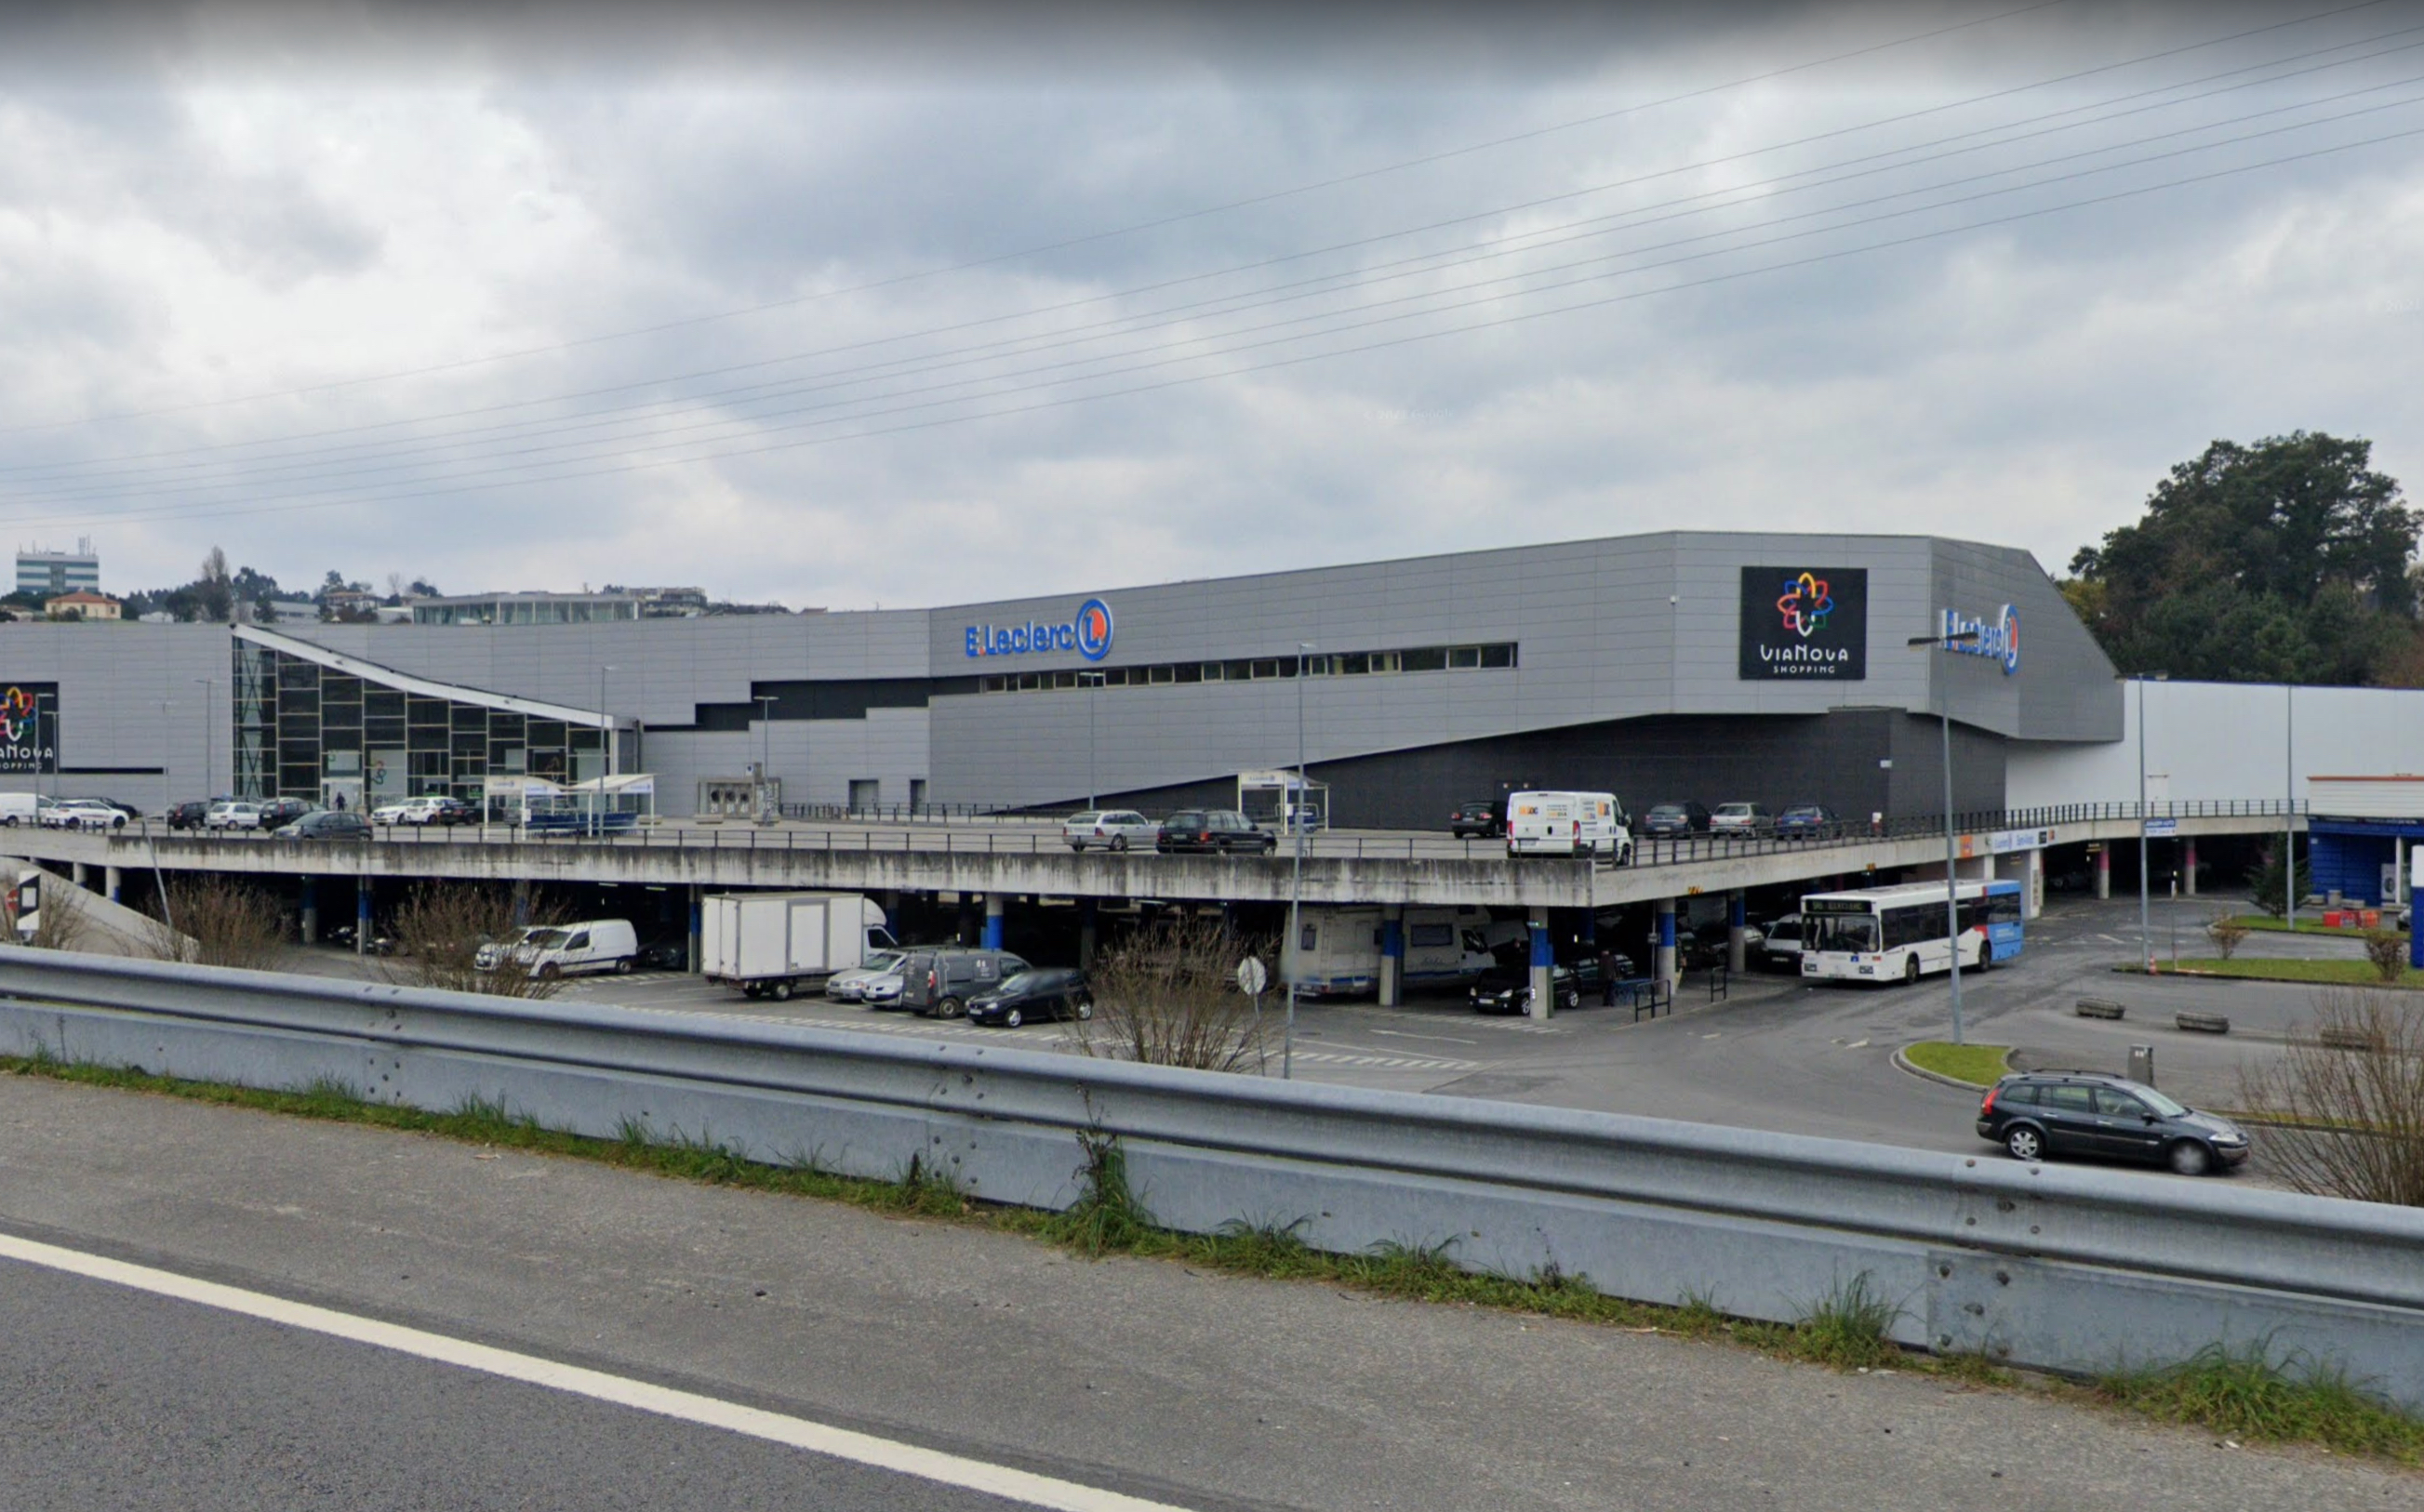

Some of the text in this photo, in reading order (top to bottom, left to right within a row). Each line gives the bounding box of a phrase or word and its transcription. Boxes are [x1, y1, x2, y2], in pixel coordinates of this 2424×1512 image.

[966, 621, 1074, 657] E.Leclerc
[1773, 665, 1836, 674] SHOPPING
[0, 762, 44, 770] OPPING
